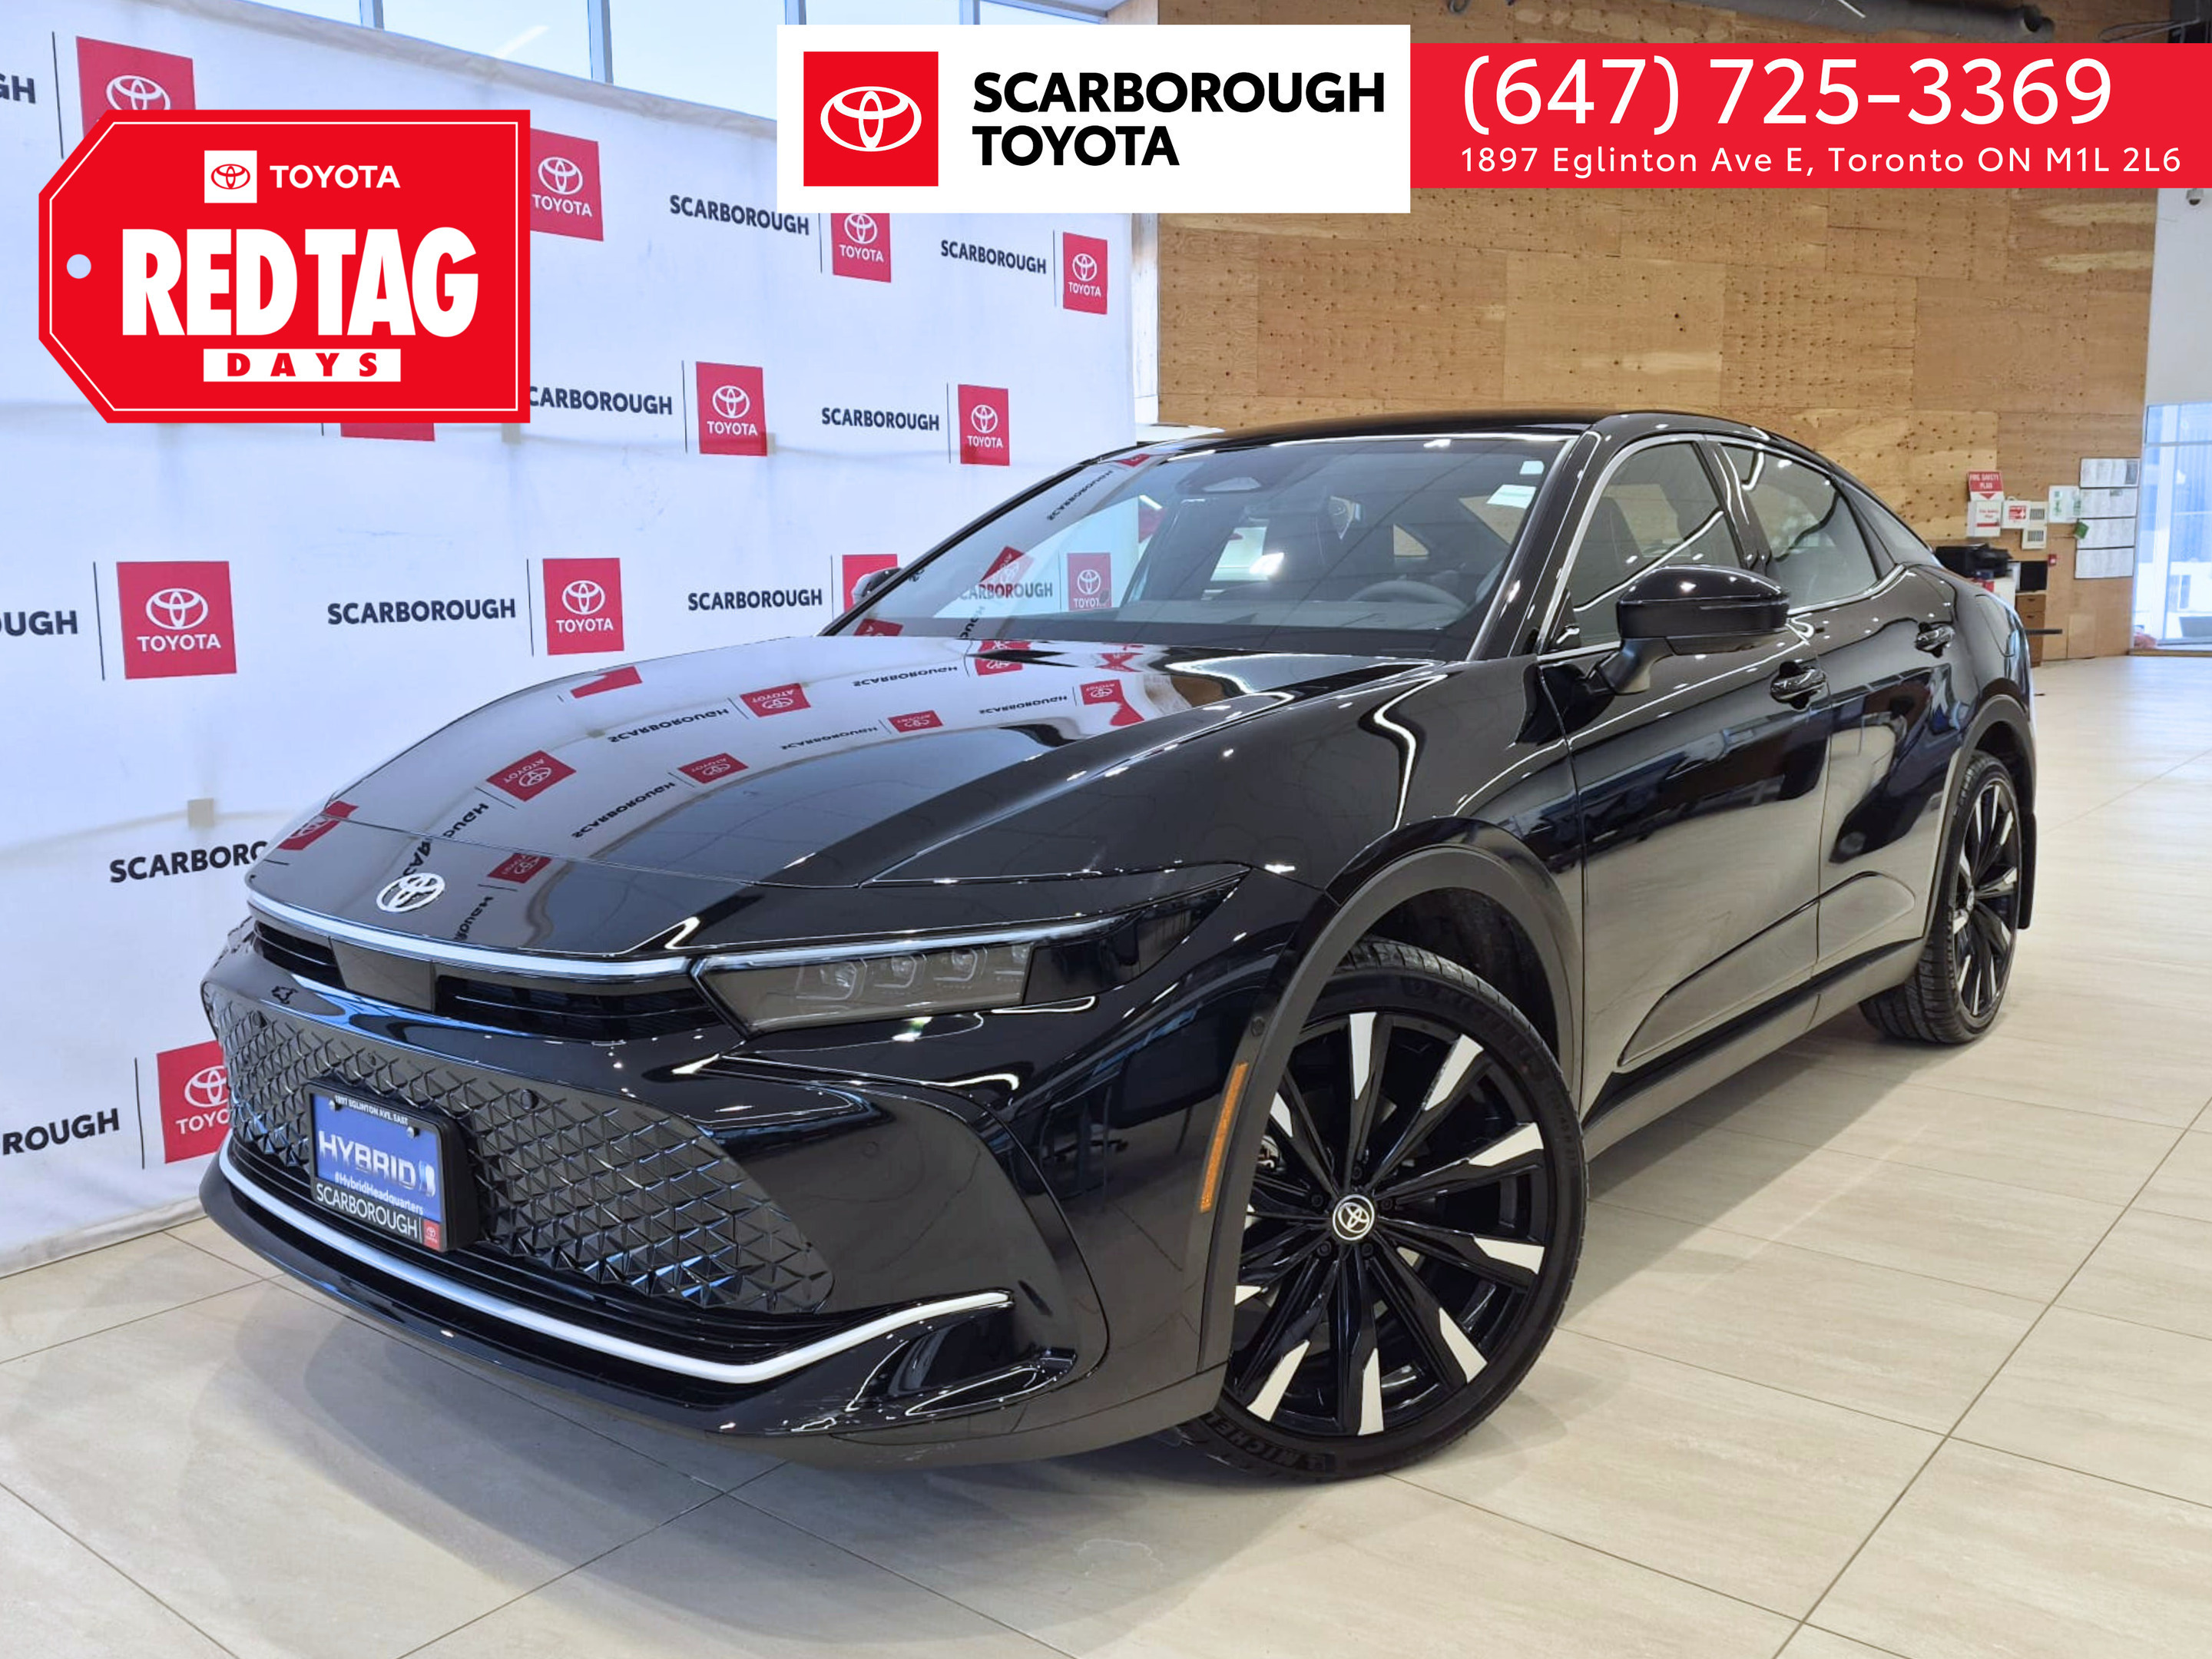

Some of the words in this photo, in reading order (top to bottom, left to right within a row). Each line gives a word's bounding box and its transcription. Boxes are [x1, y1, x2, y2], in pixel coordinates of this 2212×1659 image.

[531, 194, 593, 217] TOYOTA
[670, 194, 810, 235] SCARBOROUGH
[839, 244, 884, 263] TOYOTA
[941, 240, 1047, 274] SCARBOROUGH
[1068, 281, 1101, 297] TOYOTA
[530, 386, 673, 416] CARBOROUGH
[707, 421, 758, 435] TOYOTA
[821, 407, 940, 431] SCARBOROUGH
[967, 435, 1003, 449] TOYOTA
[327, 598, 516, 625] SCARBOROUGH
[687, 588, 823, 611] SCARBOROUGH
[0, 611, 78, 637] UGH
[555, 618, 614, 634] TOYOTA
[137, 634, 221, 652] TOYOTA
[175, 1108, 230, 1134] TOYO
[318, 1130, 417, 1188] HYBRID
[316, 1183, 419, 1239] SCARBOROUGH
